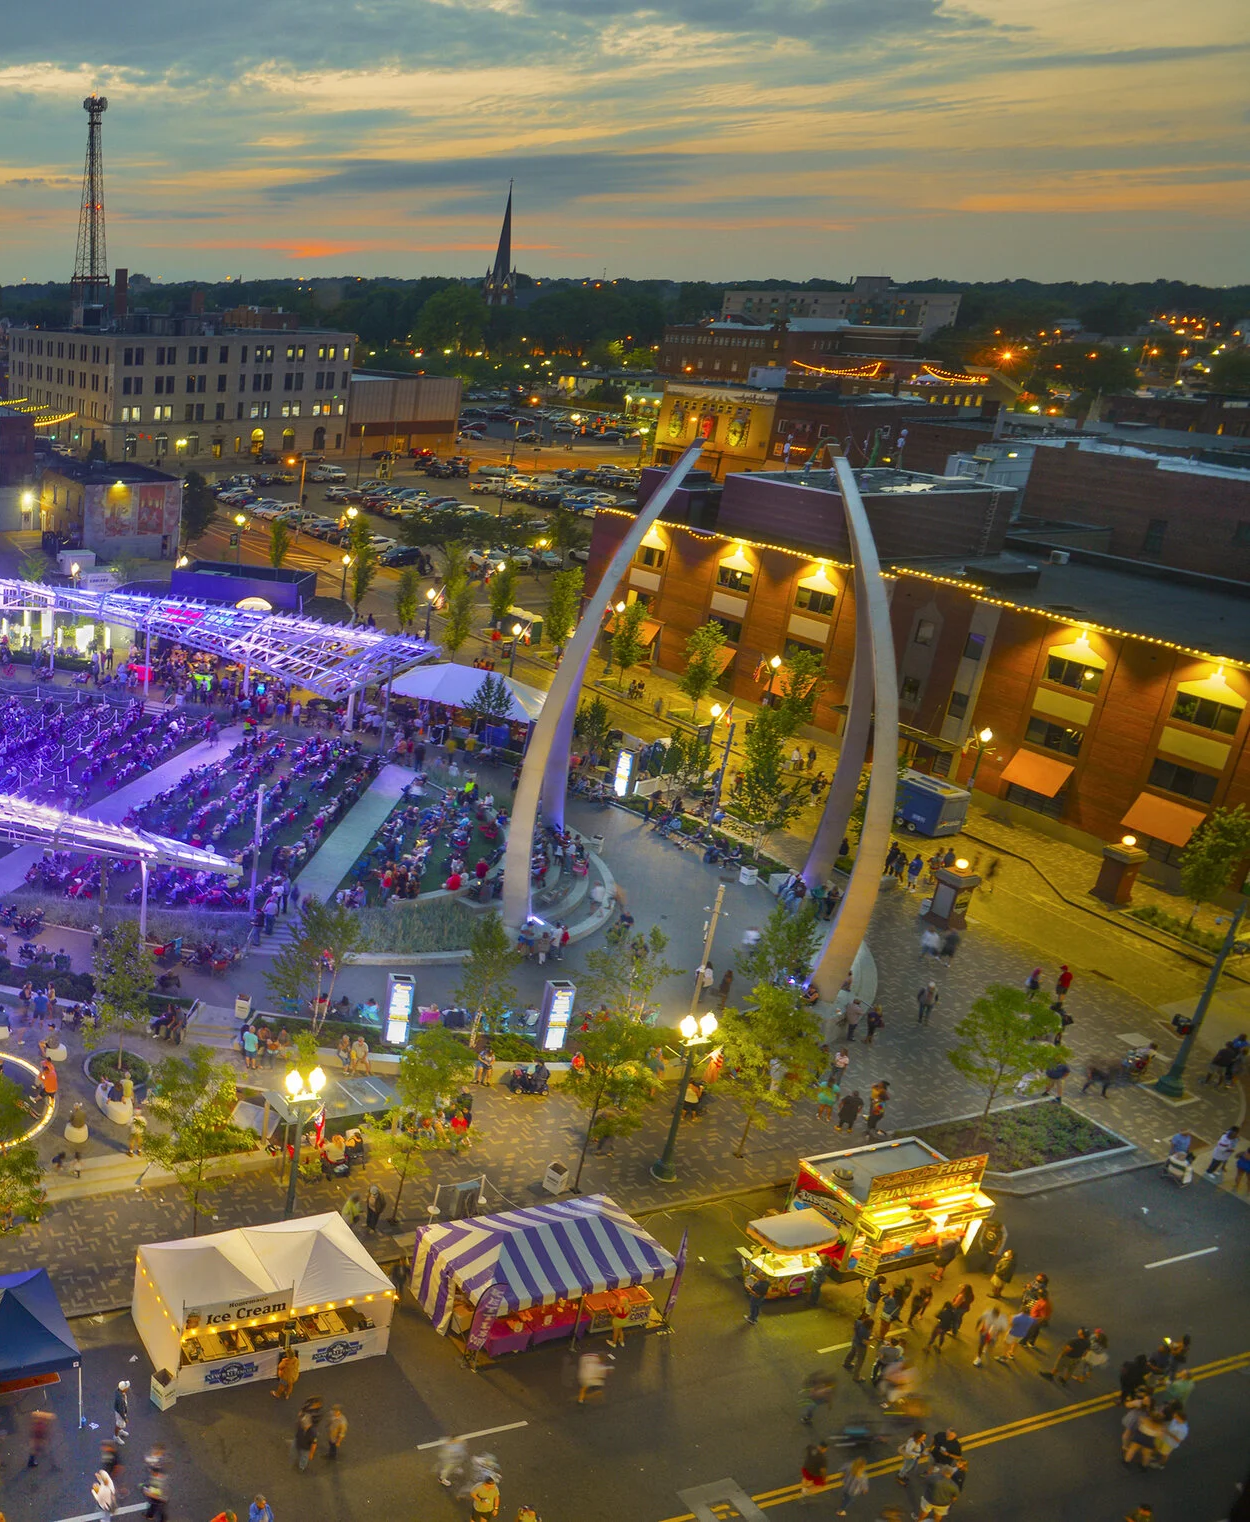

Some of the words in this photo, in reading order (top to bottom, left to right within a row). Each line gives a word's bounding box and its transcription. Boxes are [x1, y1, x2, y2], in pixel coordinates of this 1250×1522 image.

[938, 1159, 978, 1175] Fries
[876, 1184, 925, 1200] FUNNEL
[930, 1173, 973, 1188] CAKES
[229, 1296, 269, 1308] Homemade
[206, 1312, 231, 1325] Ice
[236, 1302, 287, 1319] Cream
